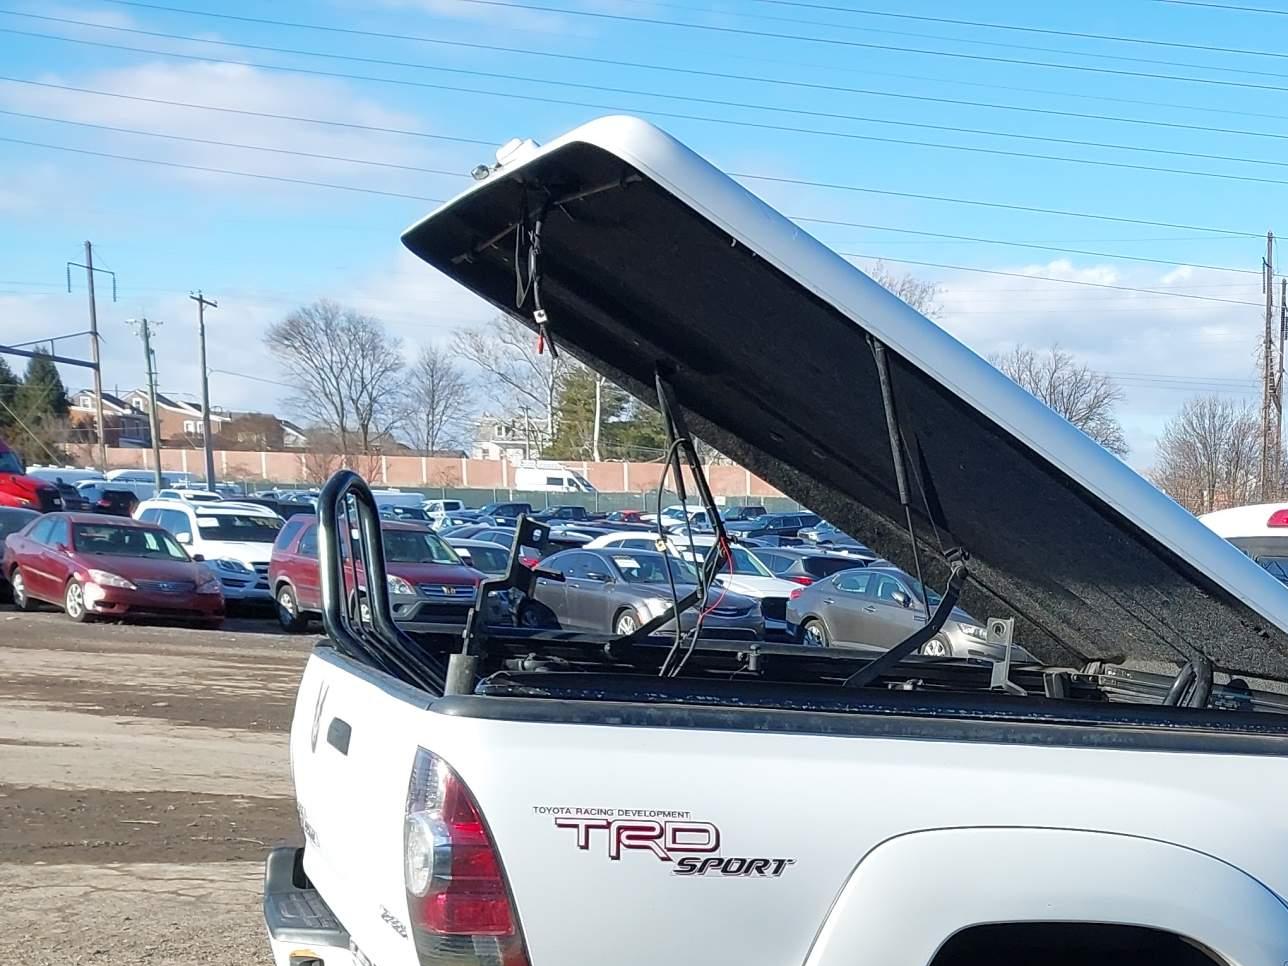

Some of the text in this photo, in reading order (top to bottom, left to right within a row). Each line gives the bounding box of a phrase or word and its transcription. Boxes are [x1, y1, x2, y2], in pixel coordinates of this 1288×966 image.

[533, 806, 690, 819] TOYOTA RACING DEVELOPMENT
[555, 817, 721, 861] TRD
[673, 857, 796, 877] SPORT
